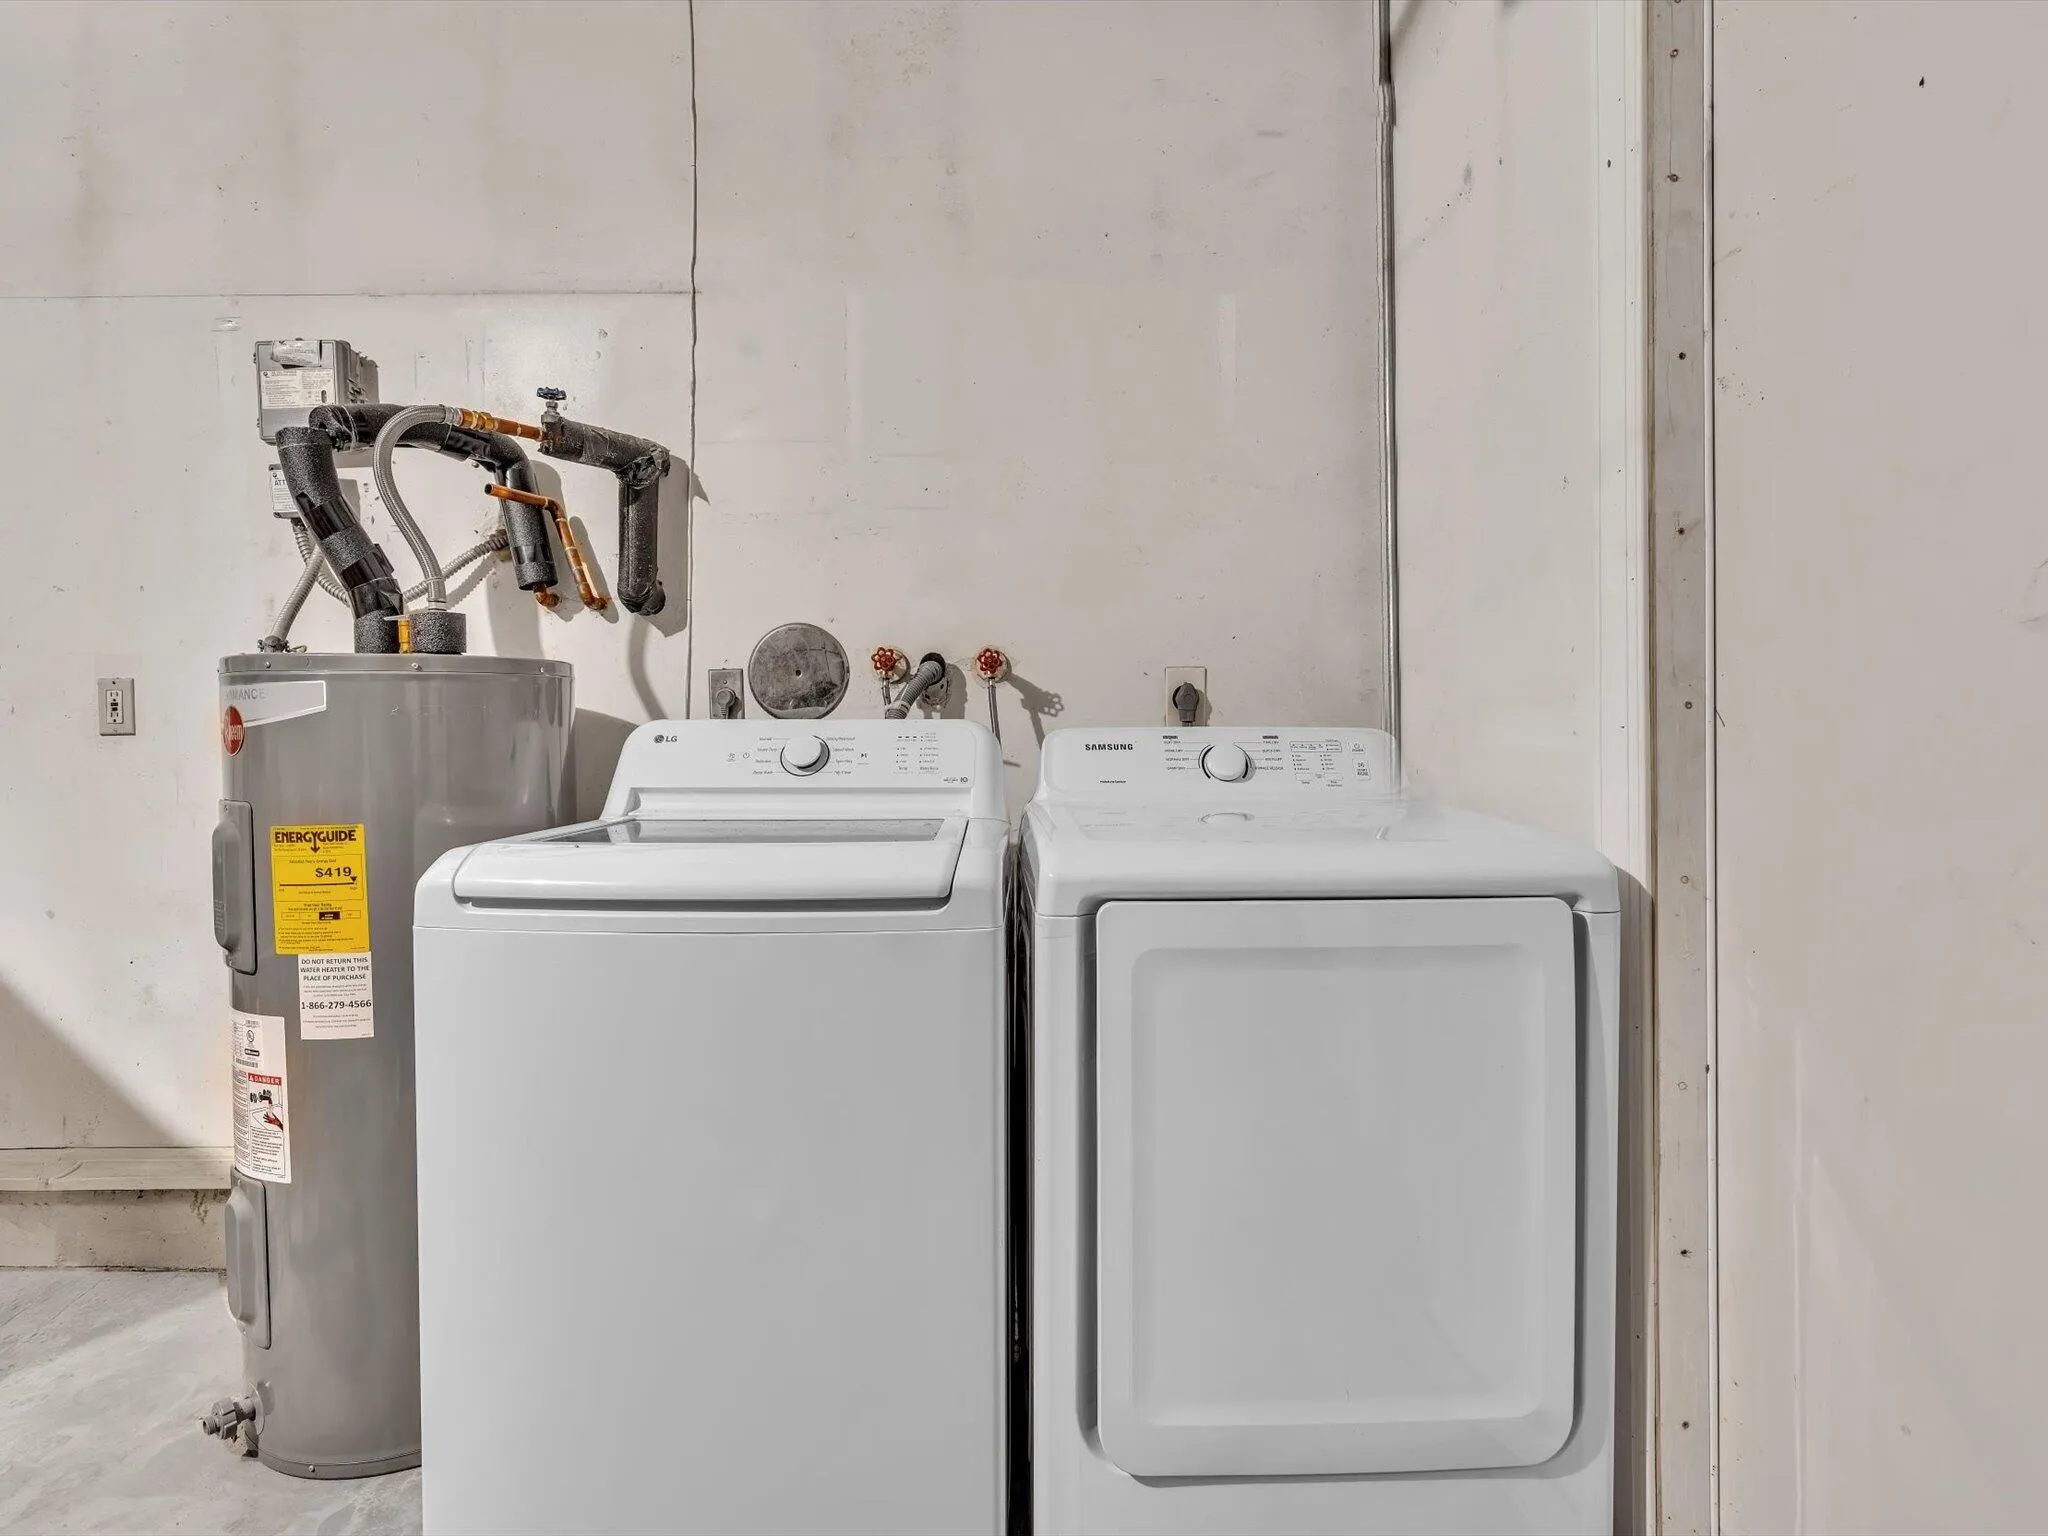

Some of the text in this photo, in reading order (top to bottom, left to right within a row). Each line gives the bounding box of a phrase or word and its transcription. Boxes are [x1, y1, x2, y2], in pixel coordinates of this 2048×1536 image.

[665, 735, 678, 743] LG
[1085, 743, 1134, 751] SAMSUNG
[274, 829, 357, 844] ENERGYGUIDE
[315, 866, 352, 878] $419
[332, 973, 367, 981] PURCHASE
[301, 999, 372, 1010] 1-866-279-4566
[253, 1075, 281, 1085] DANGER
